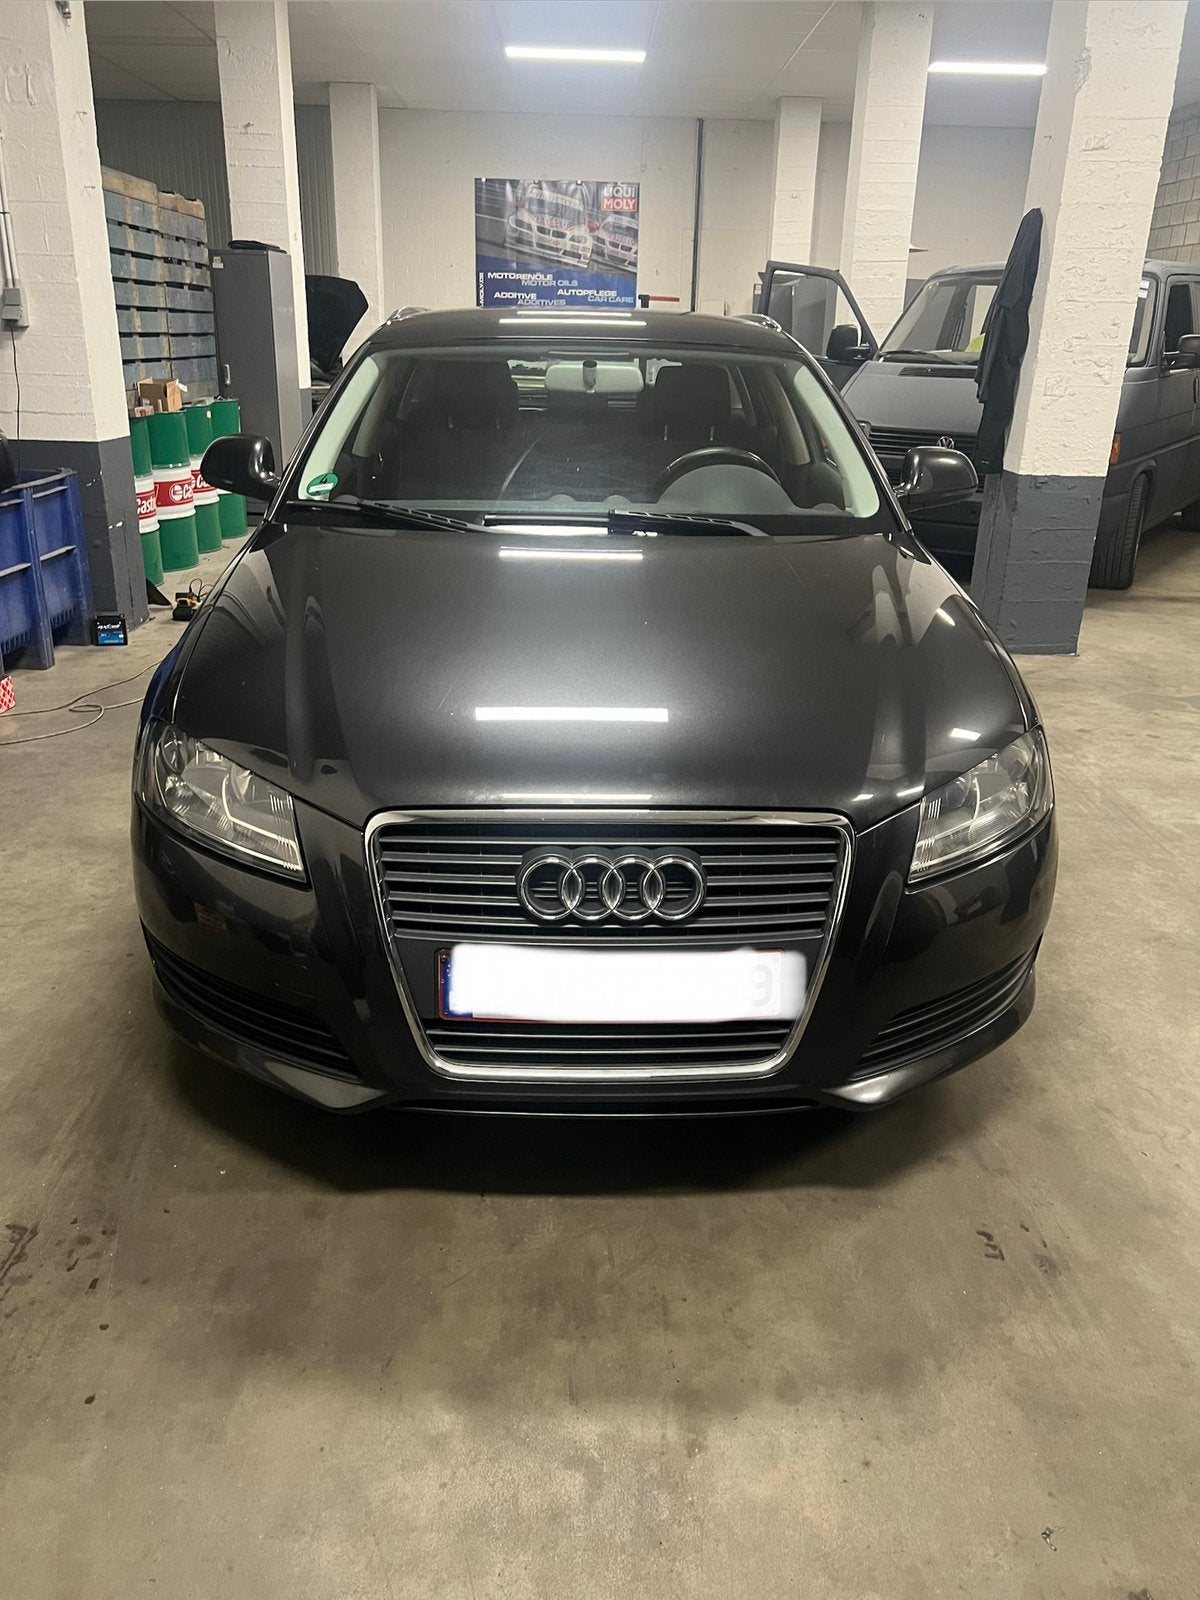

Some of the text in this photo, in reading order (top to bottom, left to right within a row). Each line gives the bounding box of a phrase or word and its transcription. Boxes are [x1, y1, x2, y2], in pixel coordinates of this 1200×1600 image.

[603, 186, 636, 198] LIQUI
[603, 198, 636, 210] MOLY
[487, 271, 553, 280] MOTORENÖLE
[557, 279, 578, 287] OILS
[494, 291, 537, 300] ADDITIVE
[557, 288, 617, 297] AUTOPFLEGE
[517, 298, 566, 306] ADDITIVES
[587, 295, 634, 304] CAR CARE
